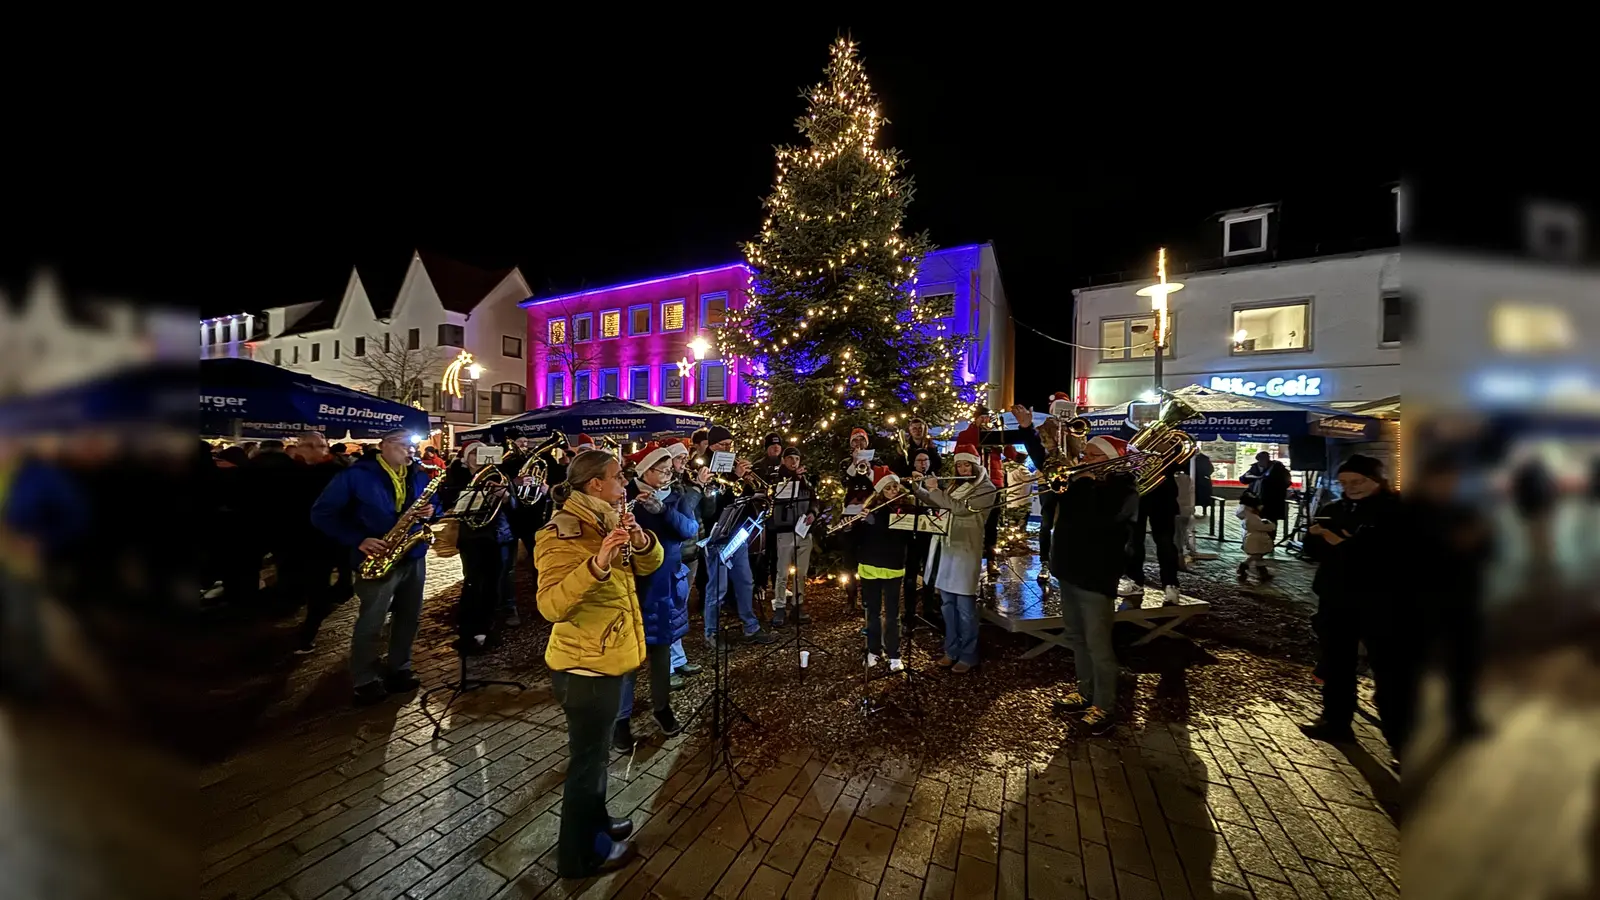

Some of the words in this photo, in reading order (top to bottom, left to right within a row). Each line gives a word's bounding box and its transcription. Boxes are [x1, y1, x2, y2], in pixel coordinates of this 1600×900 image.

[318, 404, 345, 416] Bad
[346, 407, 404, 422] Driburger
[582, 418, 600, 426] Bad
[601, 417, 646, 426] Driburger
[1208, 416, 1273, 428] Driburger
